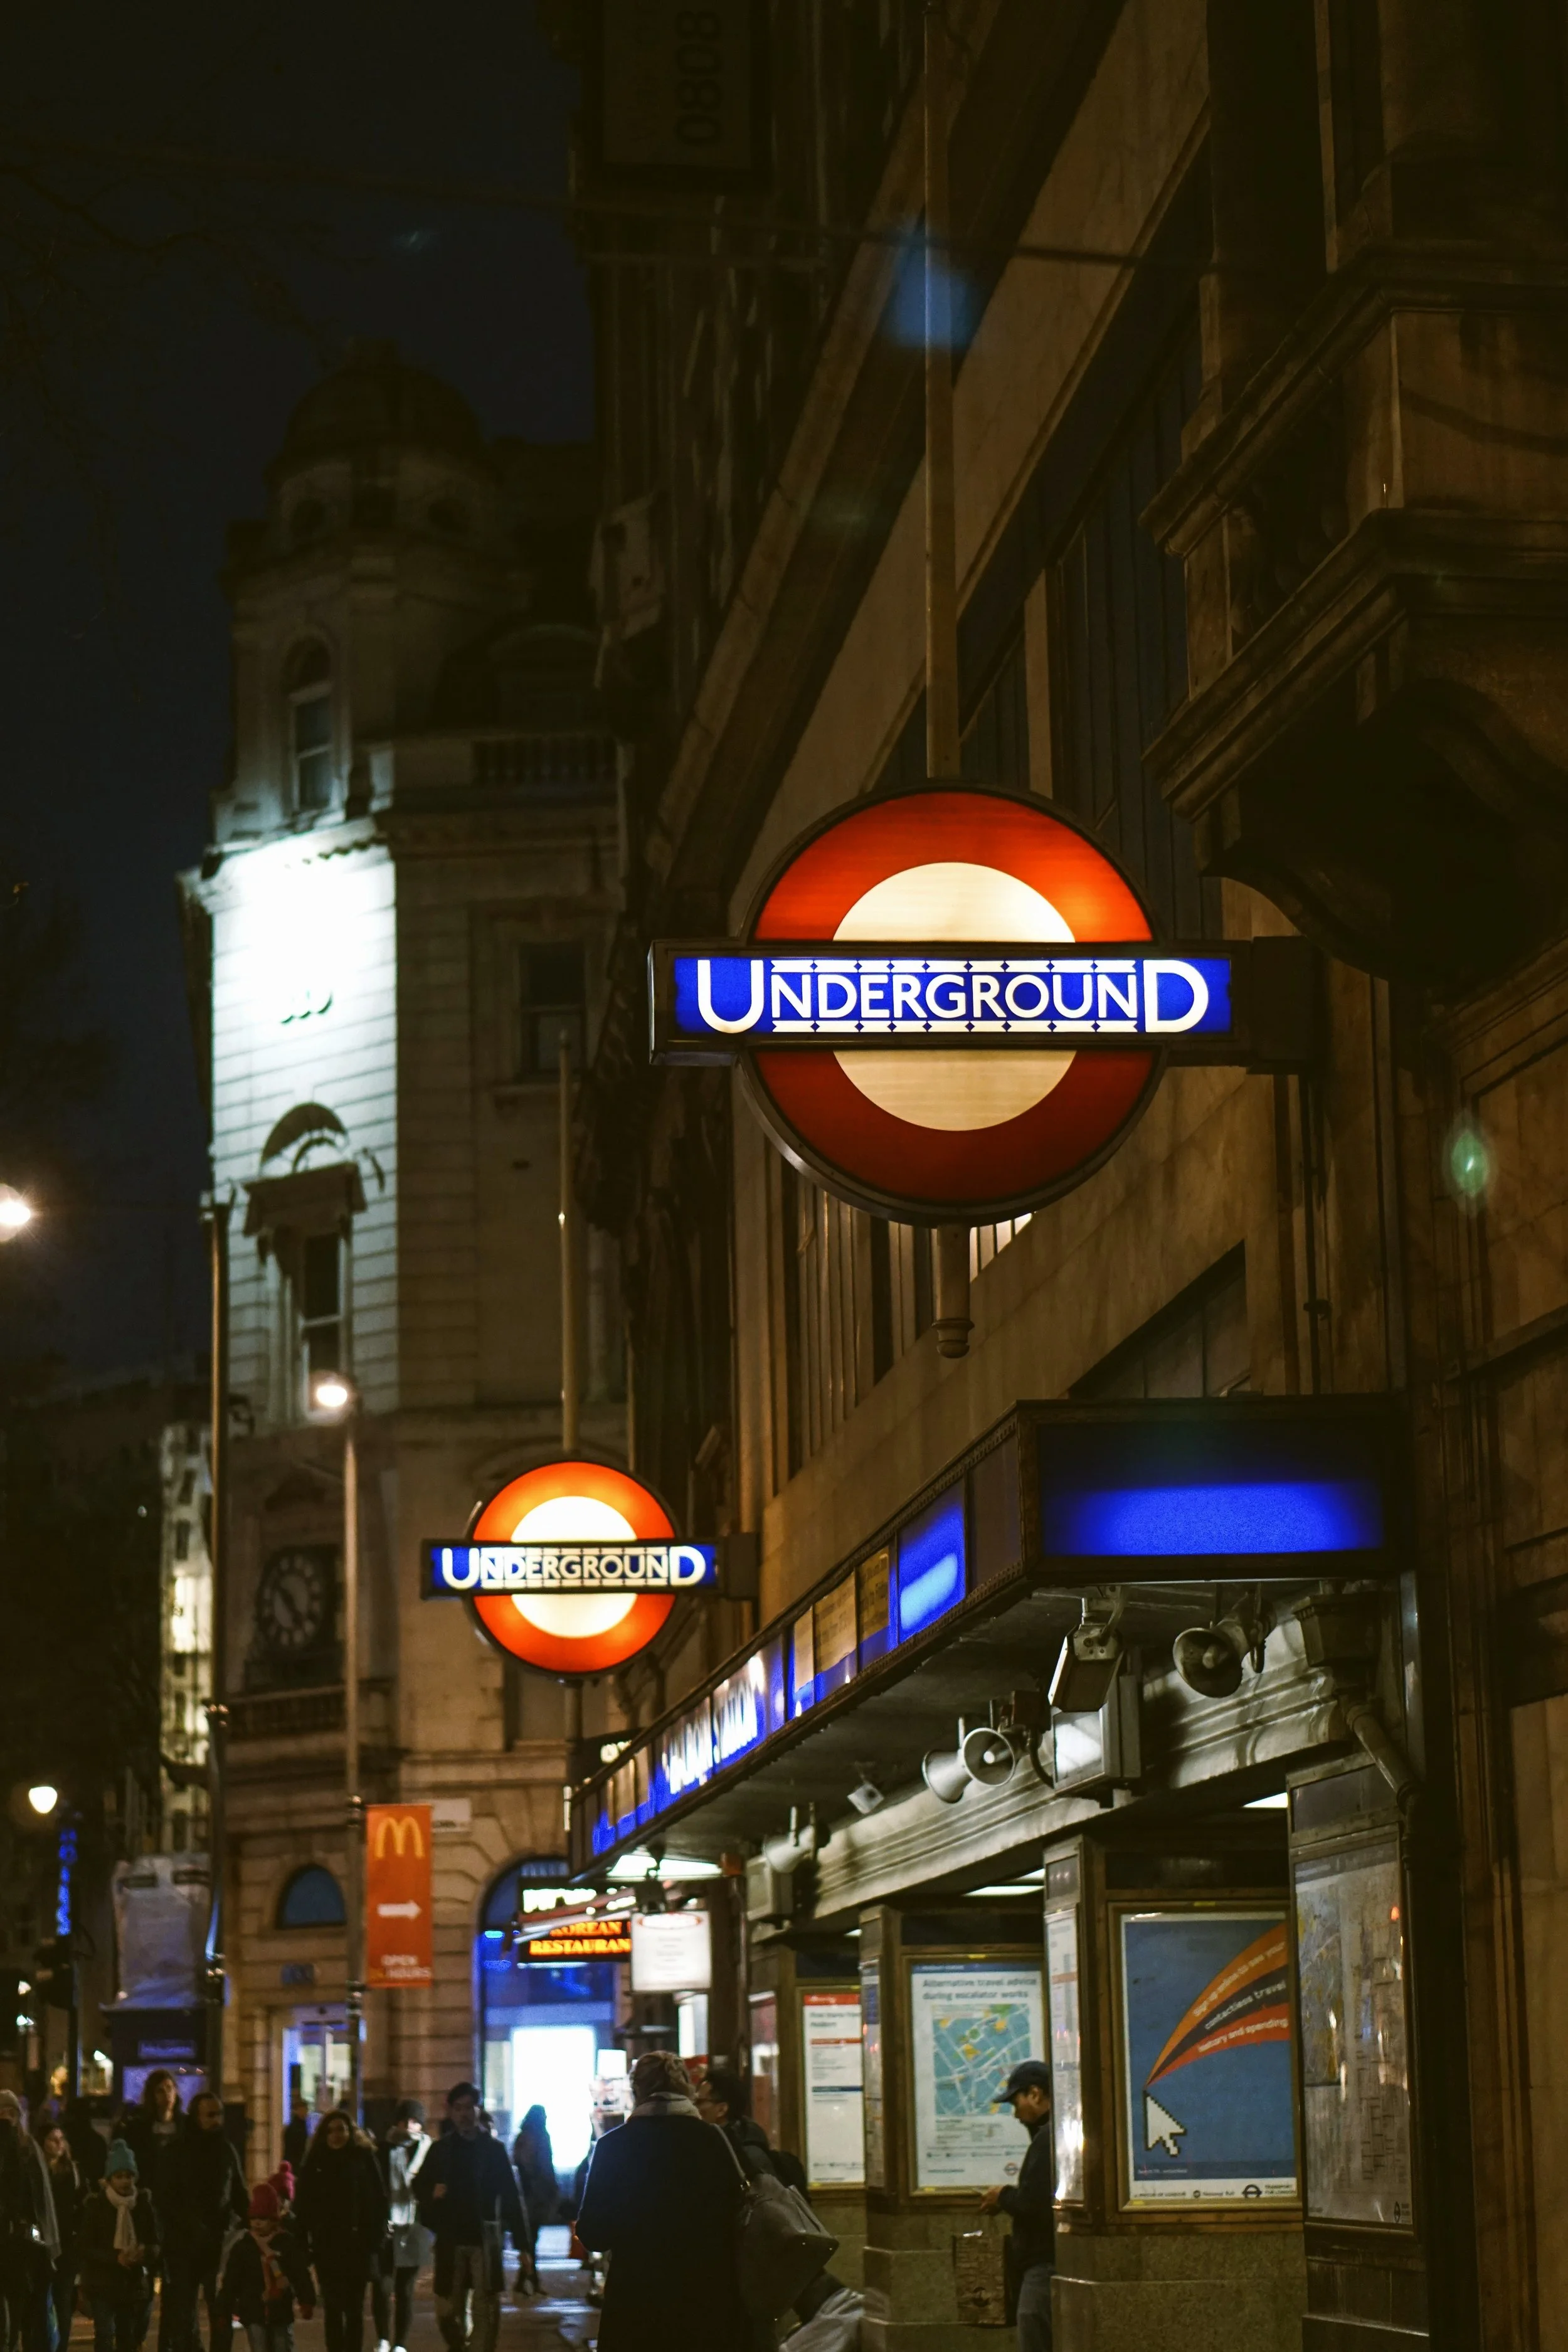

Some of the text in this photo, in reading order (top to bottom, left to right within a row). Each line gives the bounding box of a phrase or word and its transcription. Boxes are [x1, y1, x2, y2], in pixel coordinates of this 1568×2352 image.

[673, 10, 723, 146] 0808
[697, 960, 1209, 1034] UNDERGROUND
[442, 1545, 706, 1590] UNDERGROUND
[529, 1938, 632, 1956] RESTAURAN
[923, 1979, 974, 1988] Alternative
[1007, 1978, 1037, 1986] advice
[923, 1992, 952, 2001] during
[1002, 1990, 1028, 1998] works
[1205, 1979, 1286, 2030] contactless travel
[1227, 2025, 1246, 2039] and
[1244, 2016, 1289, 2033] spending
